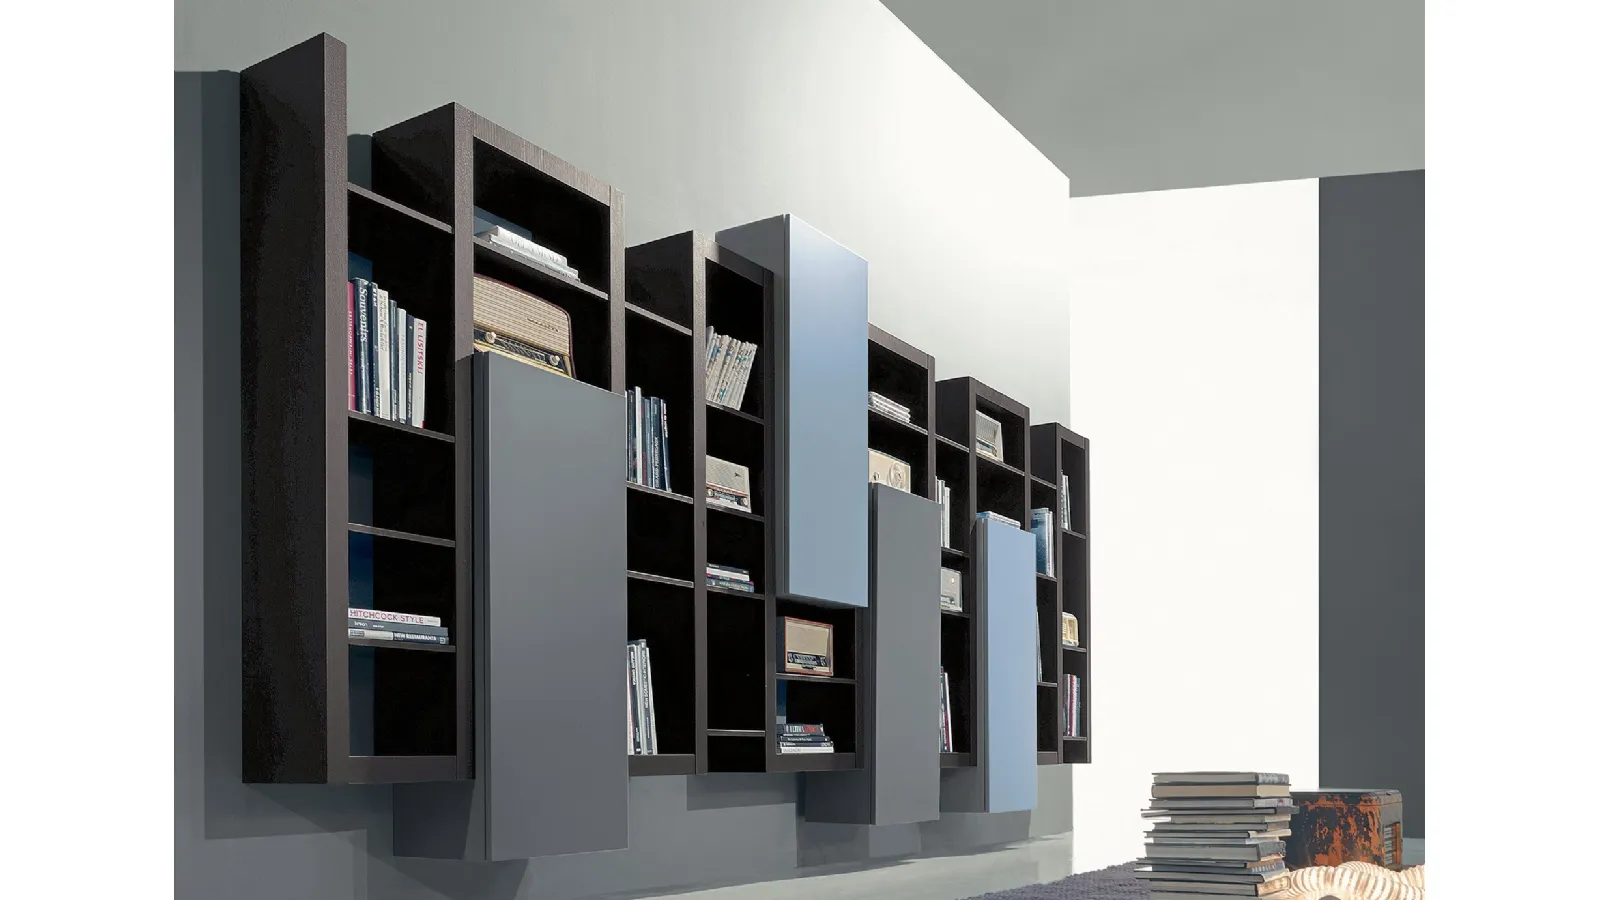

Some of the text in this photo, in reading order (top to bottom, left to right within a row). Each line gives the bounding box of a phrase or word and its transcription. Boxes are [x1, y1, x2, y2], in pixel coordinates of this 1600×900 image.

[360, 288, 368, 342] Souvenirs
[417, 322, 424, 331] EL
[349, 609, 424, 624] HITCHCOCK STYLE
